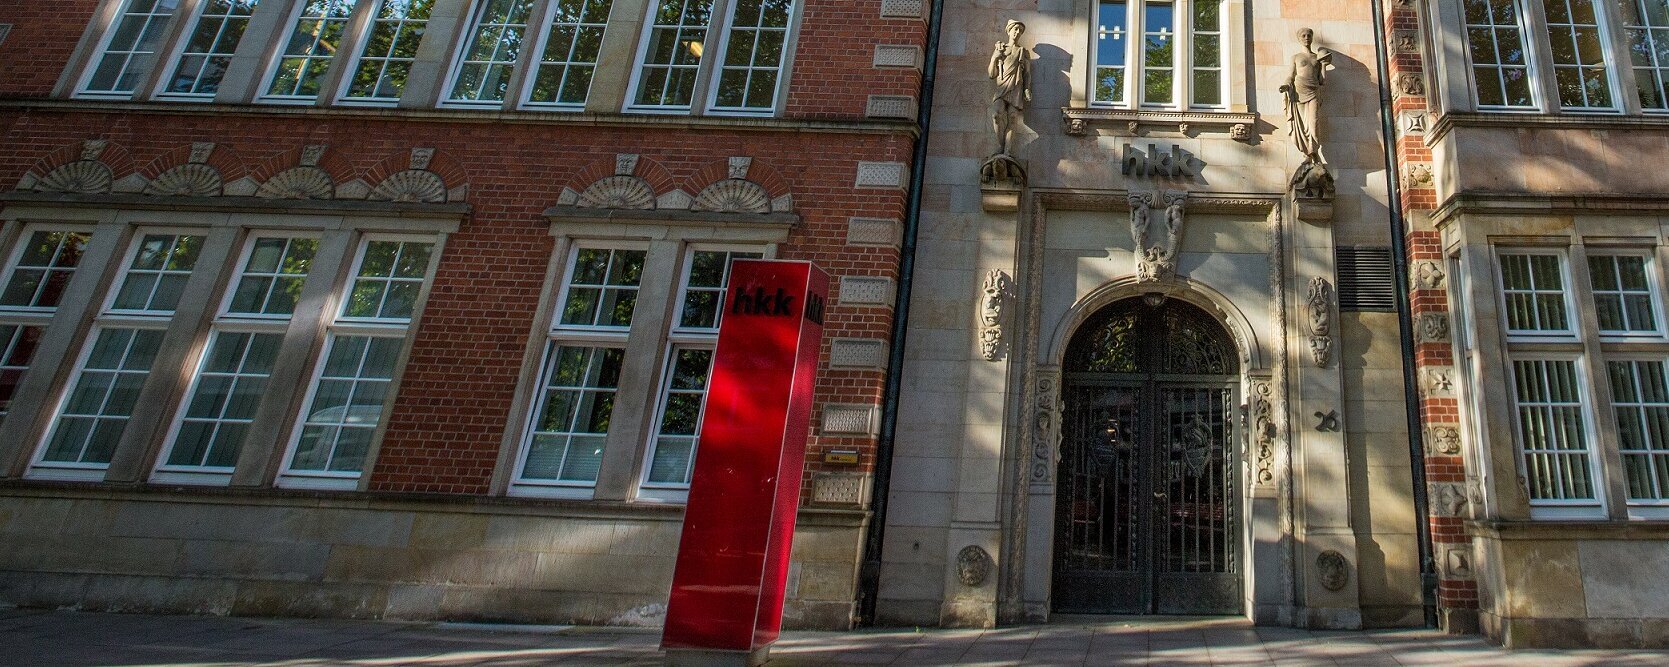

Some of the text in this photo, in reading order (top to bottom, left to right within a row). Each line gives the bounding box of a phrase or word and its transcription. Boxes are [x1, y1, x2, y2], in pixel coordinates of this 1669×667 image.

[1122, 143, 1194, 176] hkk
[732, 287, 794, 315] hkk
[1314, 410, 1336, 432] 26
